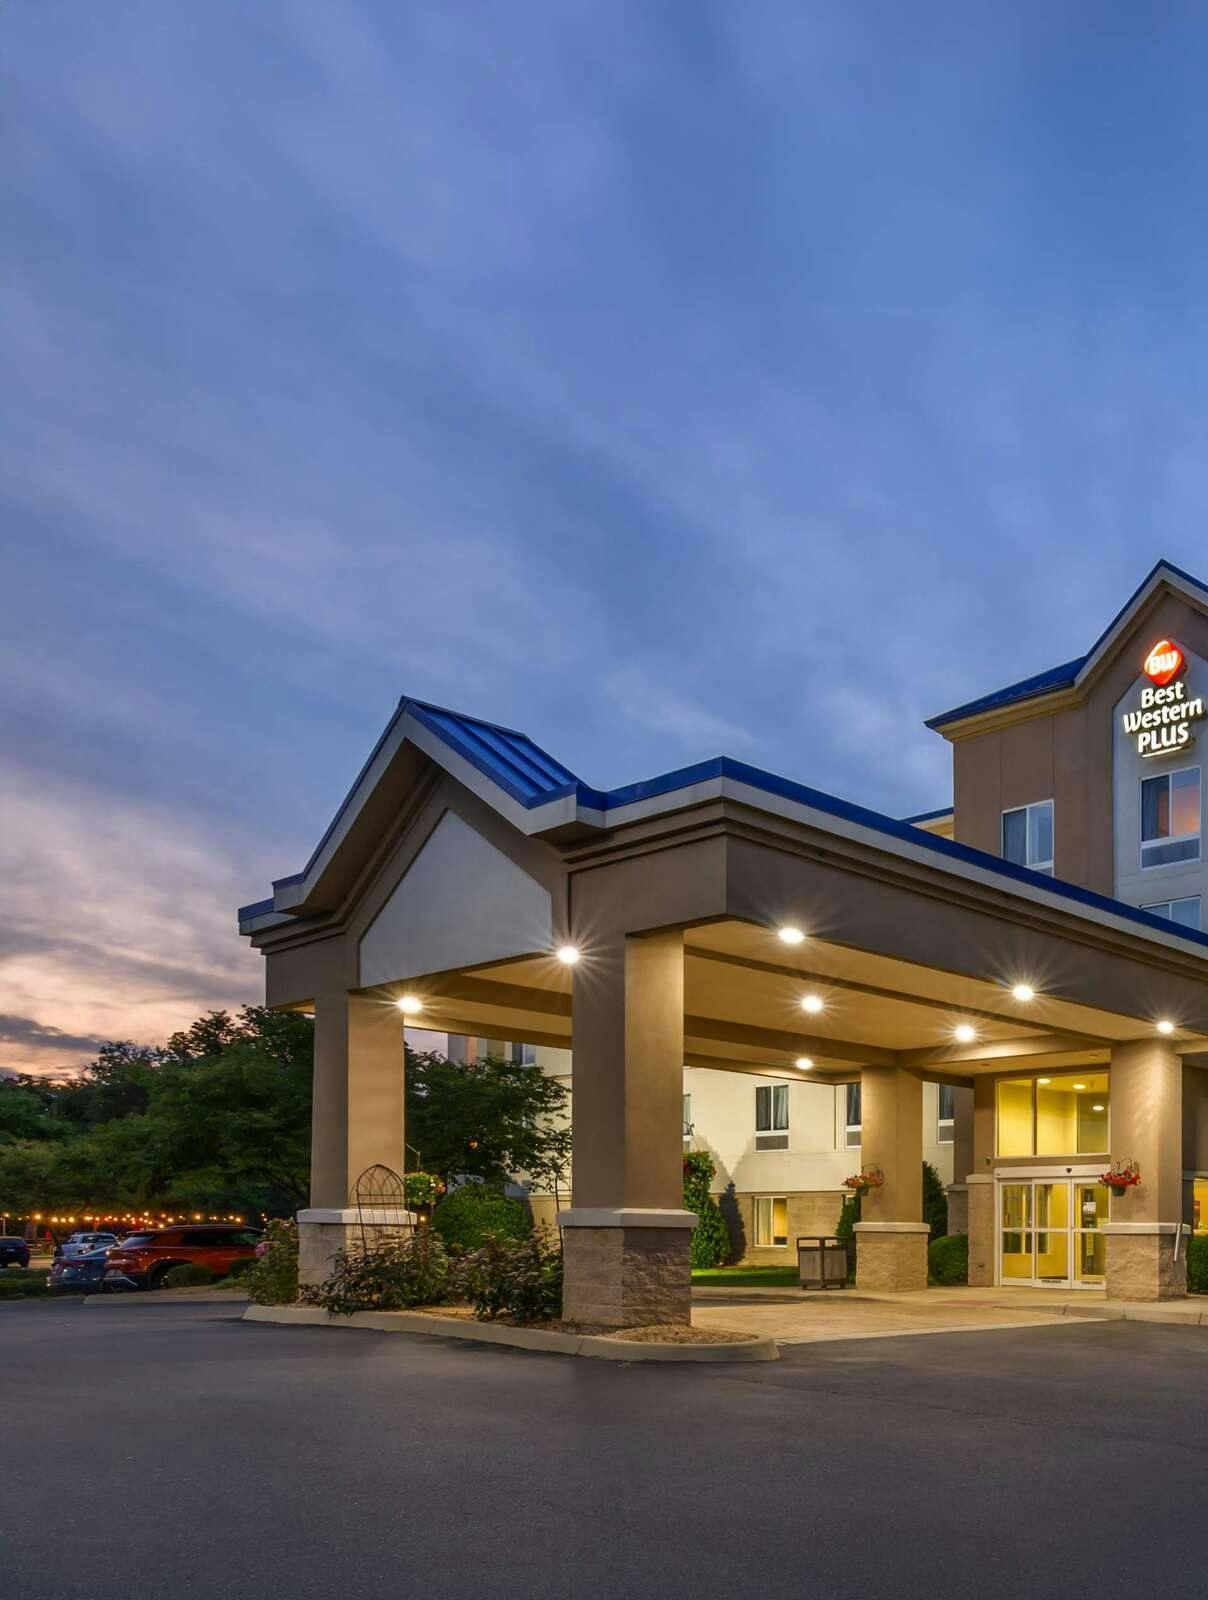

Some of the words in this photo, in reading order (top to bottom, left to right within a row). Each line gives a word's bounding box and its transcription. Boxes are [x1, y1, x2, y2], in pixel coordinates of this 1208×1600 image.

[1148, 650, 1179, 675] BW
[1141, 681, 1184, 708] Best
[1123, 698, 1203, 733] Western
[1138, 722, 1188, 752] PLUS
